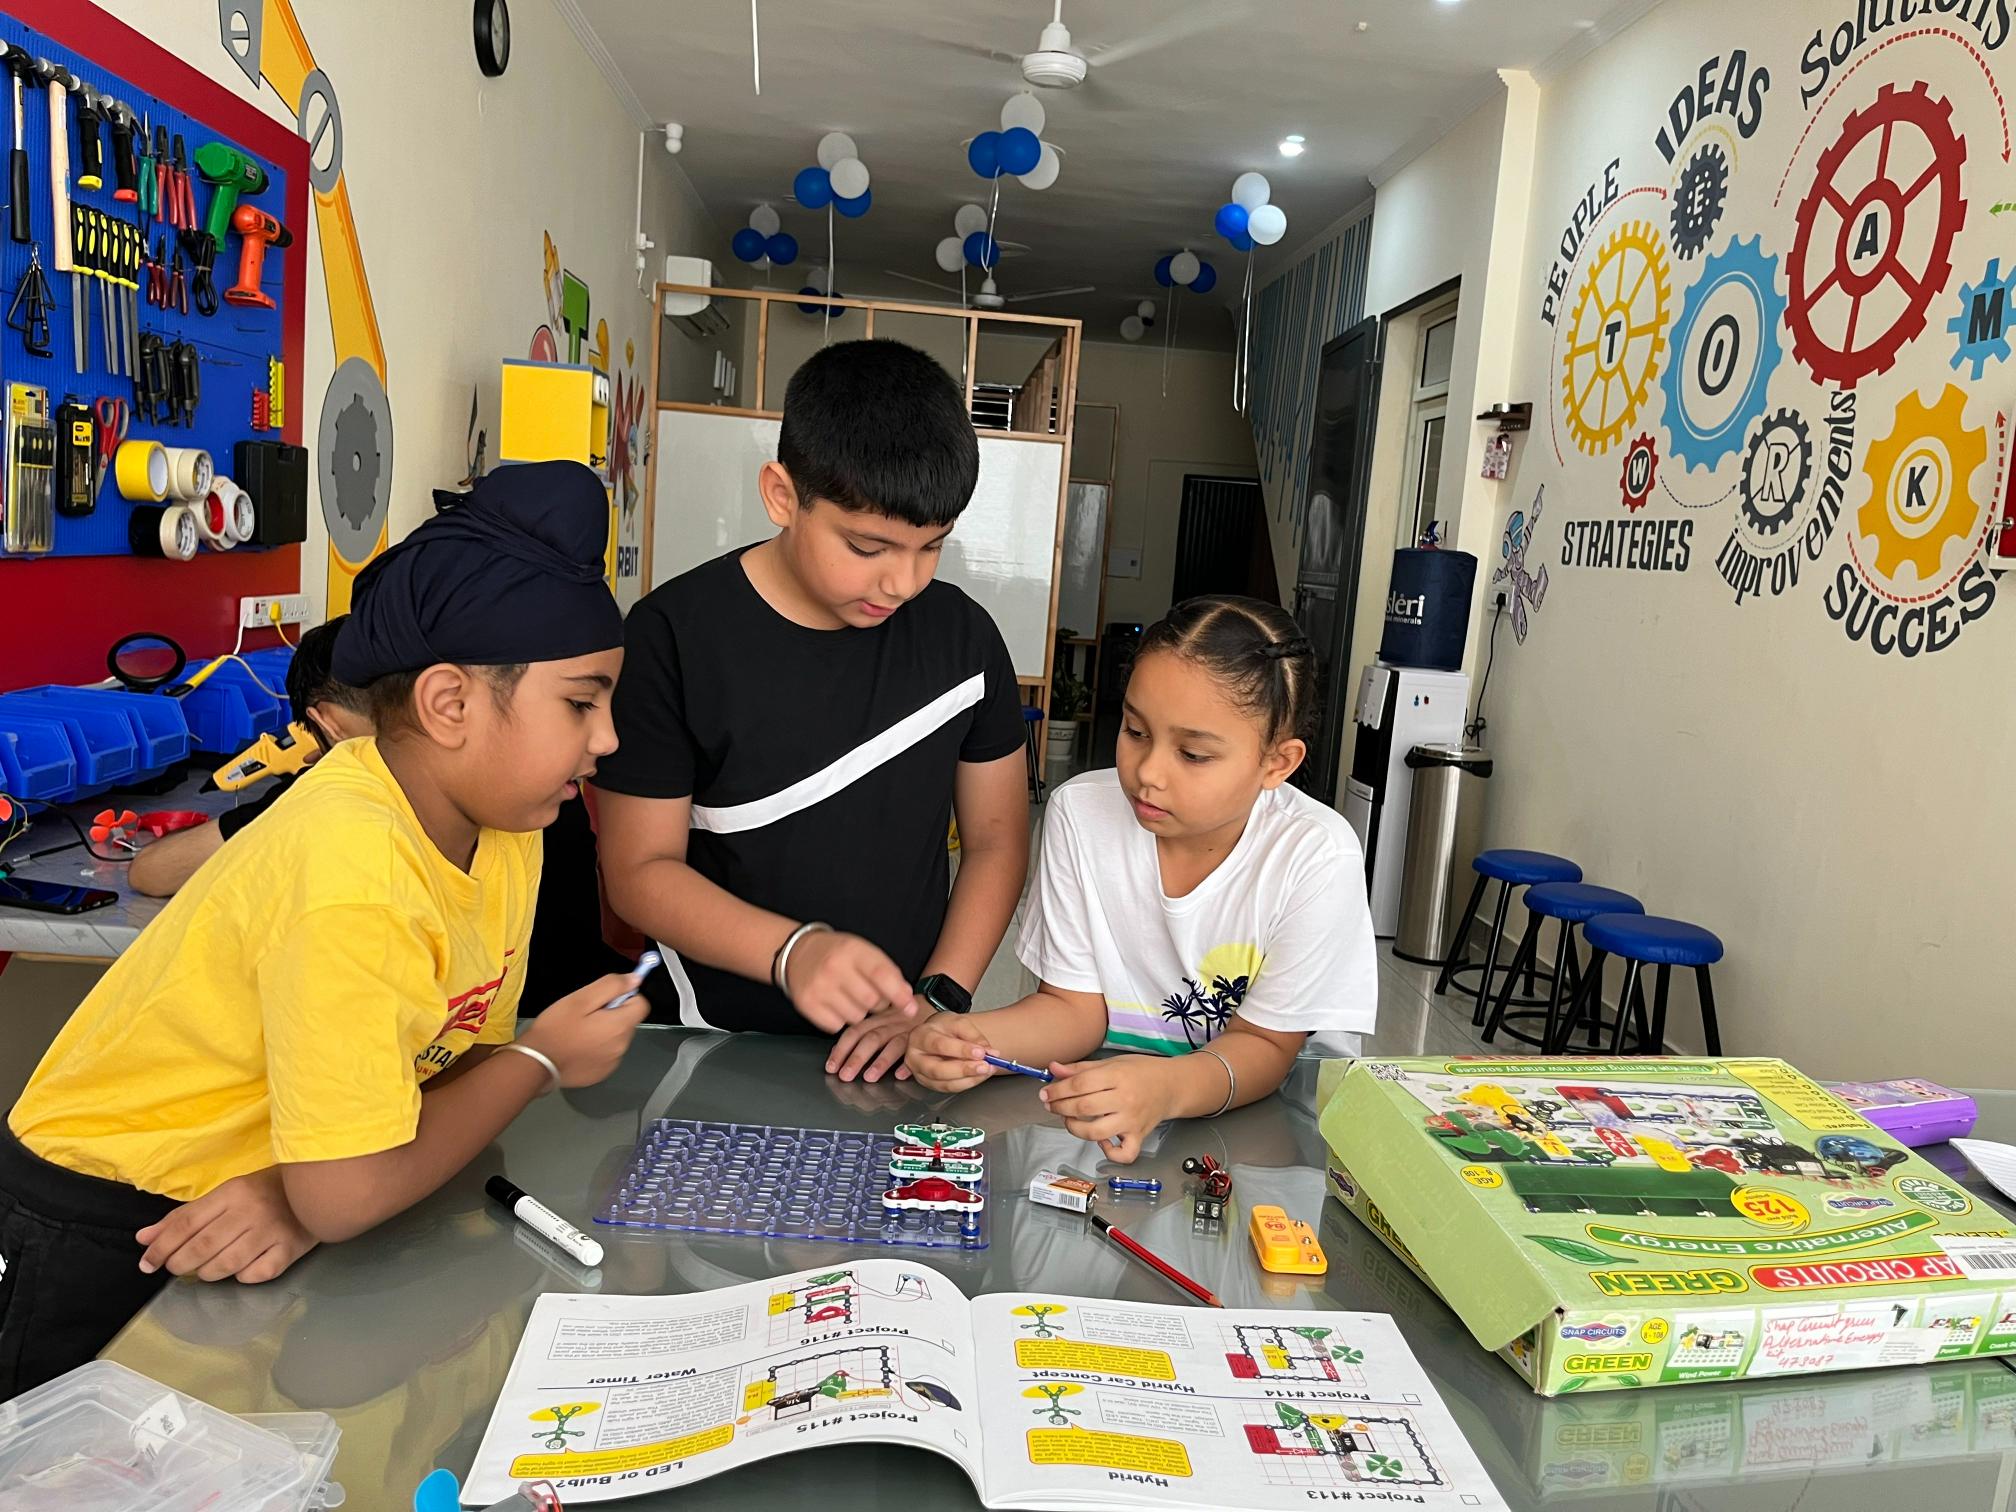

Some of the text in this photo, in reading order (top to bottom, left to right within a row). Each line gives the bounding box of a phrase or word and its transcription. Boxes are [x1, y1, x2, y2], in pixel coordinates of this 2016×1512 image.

[1655, 49, 1770, 164] IDEAS
[1693, 182, 1705, 215] E
[1540, 157, 1621, 328] PEOPLE
[1853, 212, 1879, 261] A
[1967, 287, 2006, 345] M
[1605, 321, 1622, 364] T
[1630, 460, 1647, 485] W
[1760, 442, 1790, 502] R
[1905, 464, 1930, 509] K
[1561, 519, 1694, 572] STRATEGIES
[617, 545, 640, 577] RBIT
[414, 1045, 460, 1069] STA
[1743, 1199, 1797, 1216] 125
[1619, 1233, 1747, 1256] Energy
[1753, 1218, 1909, 1255] Alternative
[1590, 1270, 1745, 1296] GREEN
[1774, 1255, 1957, 1288] AP CIRCUITS
[800, 1325, 909, 1345] Project #116
[1561, 1327, 1626, 1336] SNAP CIRCUITS
[1648, 1323, 1663, 1331] AGE
[1565, 1354, 1652, 1372] GREEN
[1678, 1369, 1721, 1379] Wind Power
[586, 1367, 697, 1386] Water Timer
[1031, 1369, 1196, 1394] Hybrid Car Concept
[1264, 1389, 1370, 1401] Project #114
[795, 1411, 919, 1433] Project #115
[556, 1460, 684, 1489] LED or Bulb?
[1107, 1471, 1169, 1488] Hybrid
[1305, 1489, 1425, 1505] Project #113
